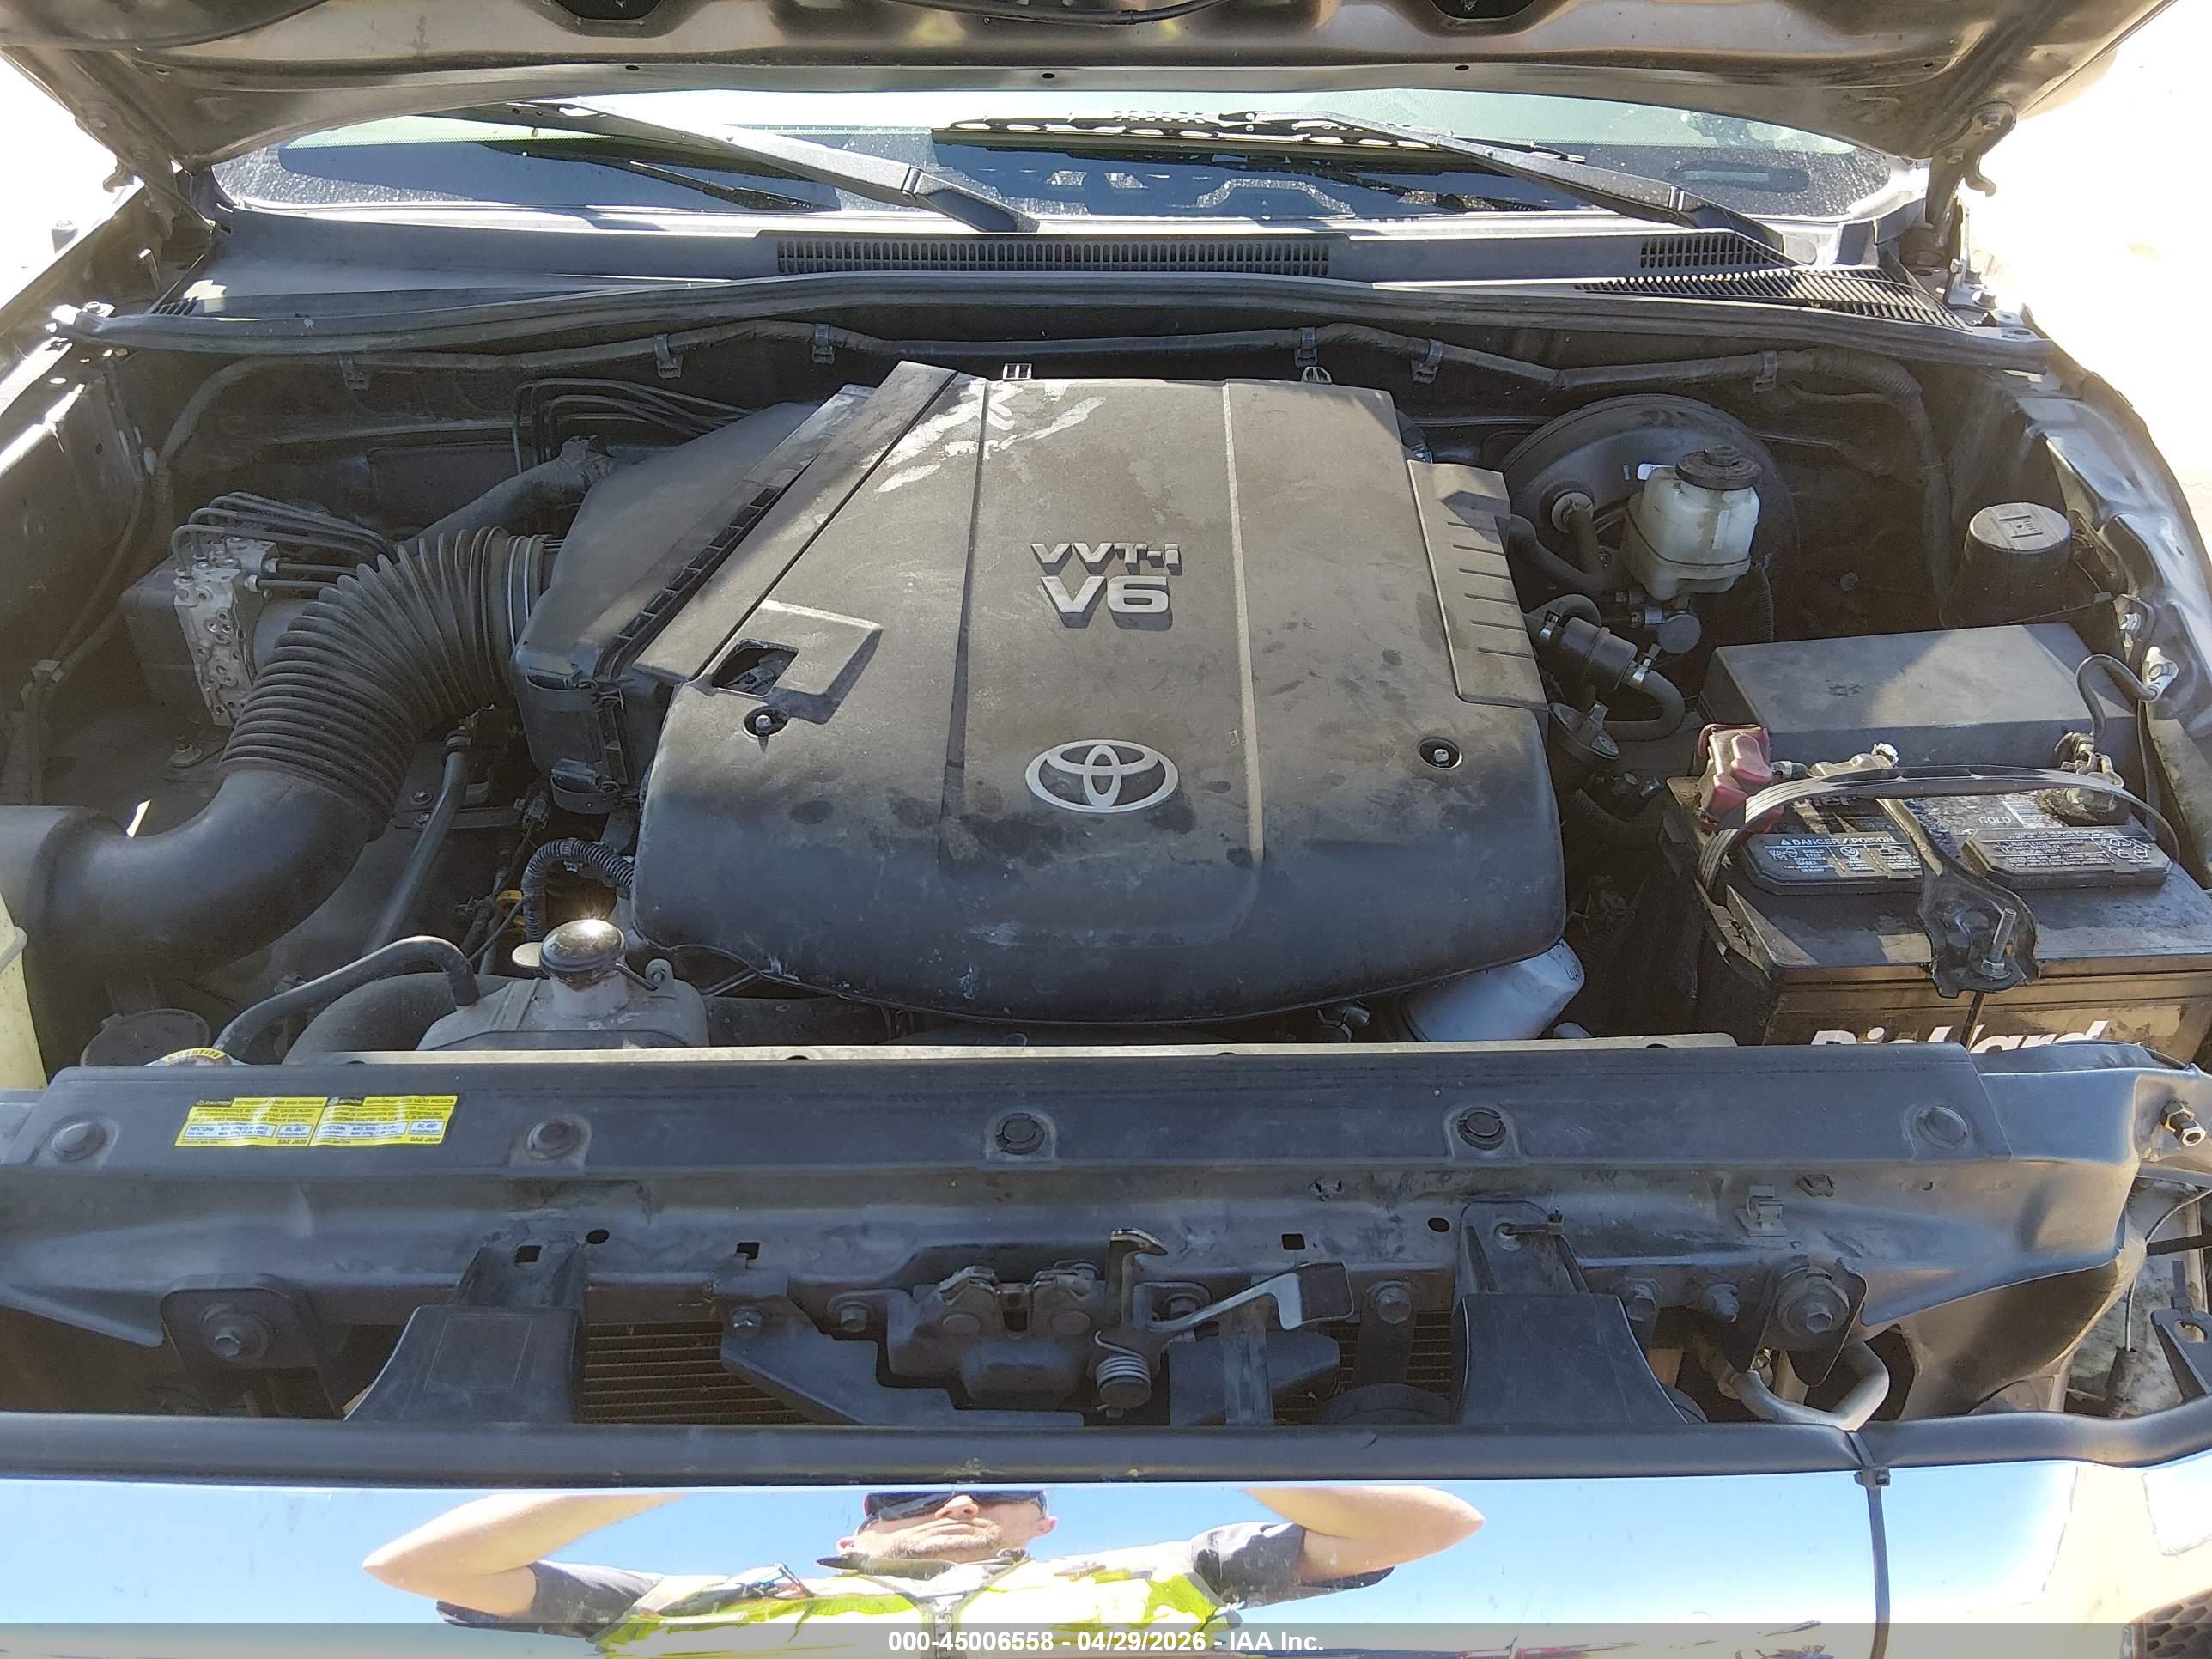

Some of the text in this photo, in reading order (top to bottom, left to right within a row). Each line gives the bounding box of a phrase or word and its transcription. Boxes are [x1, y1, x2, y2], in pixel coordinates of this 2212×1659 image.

[1030, 542, 1182, 571] VVT-i
[1039, 575, 1172, 622] V6
[1978, 816, 2012, 824] GOLD
